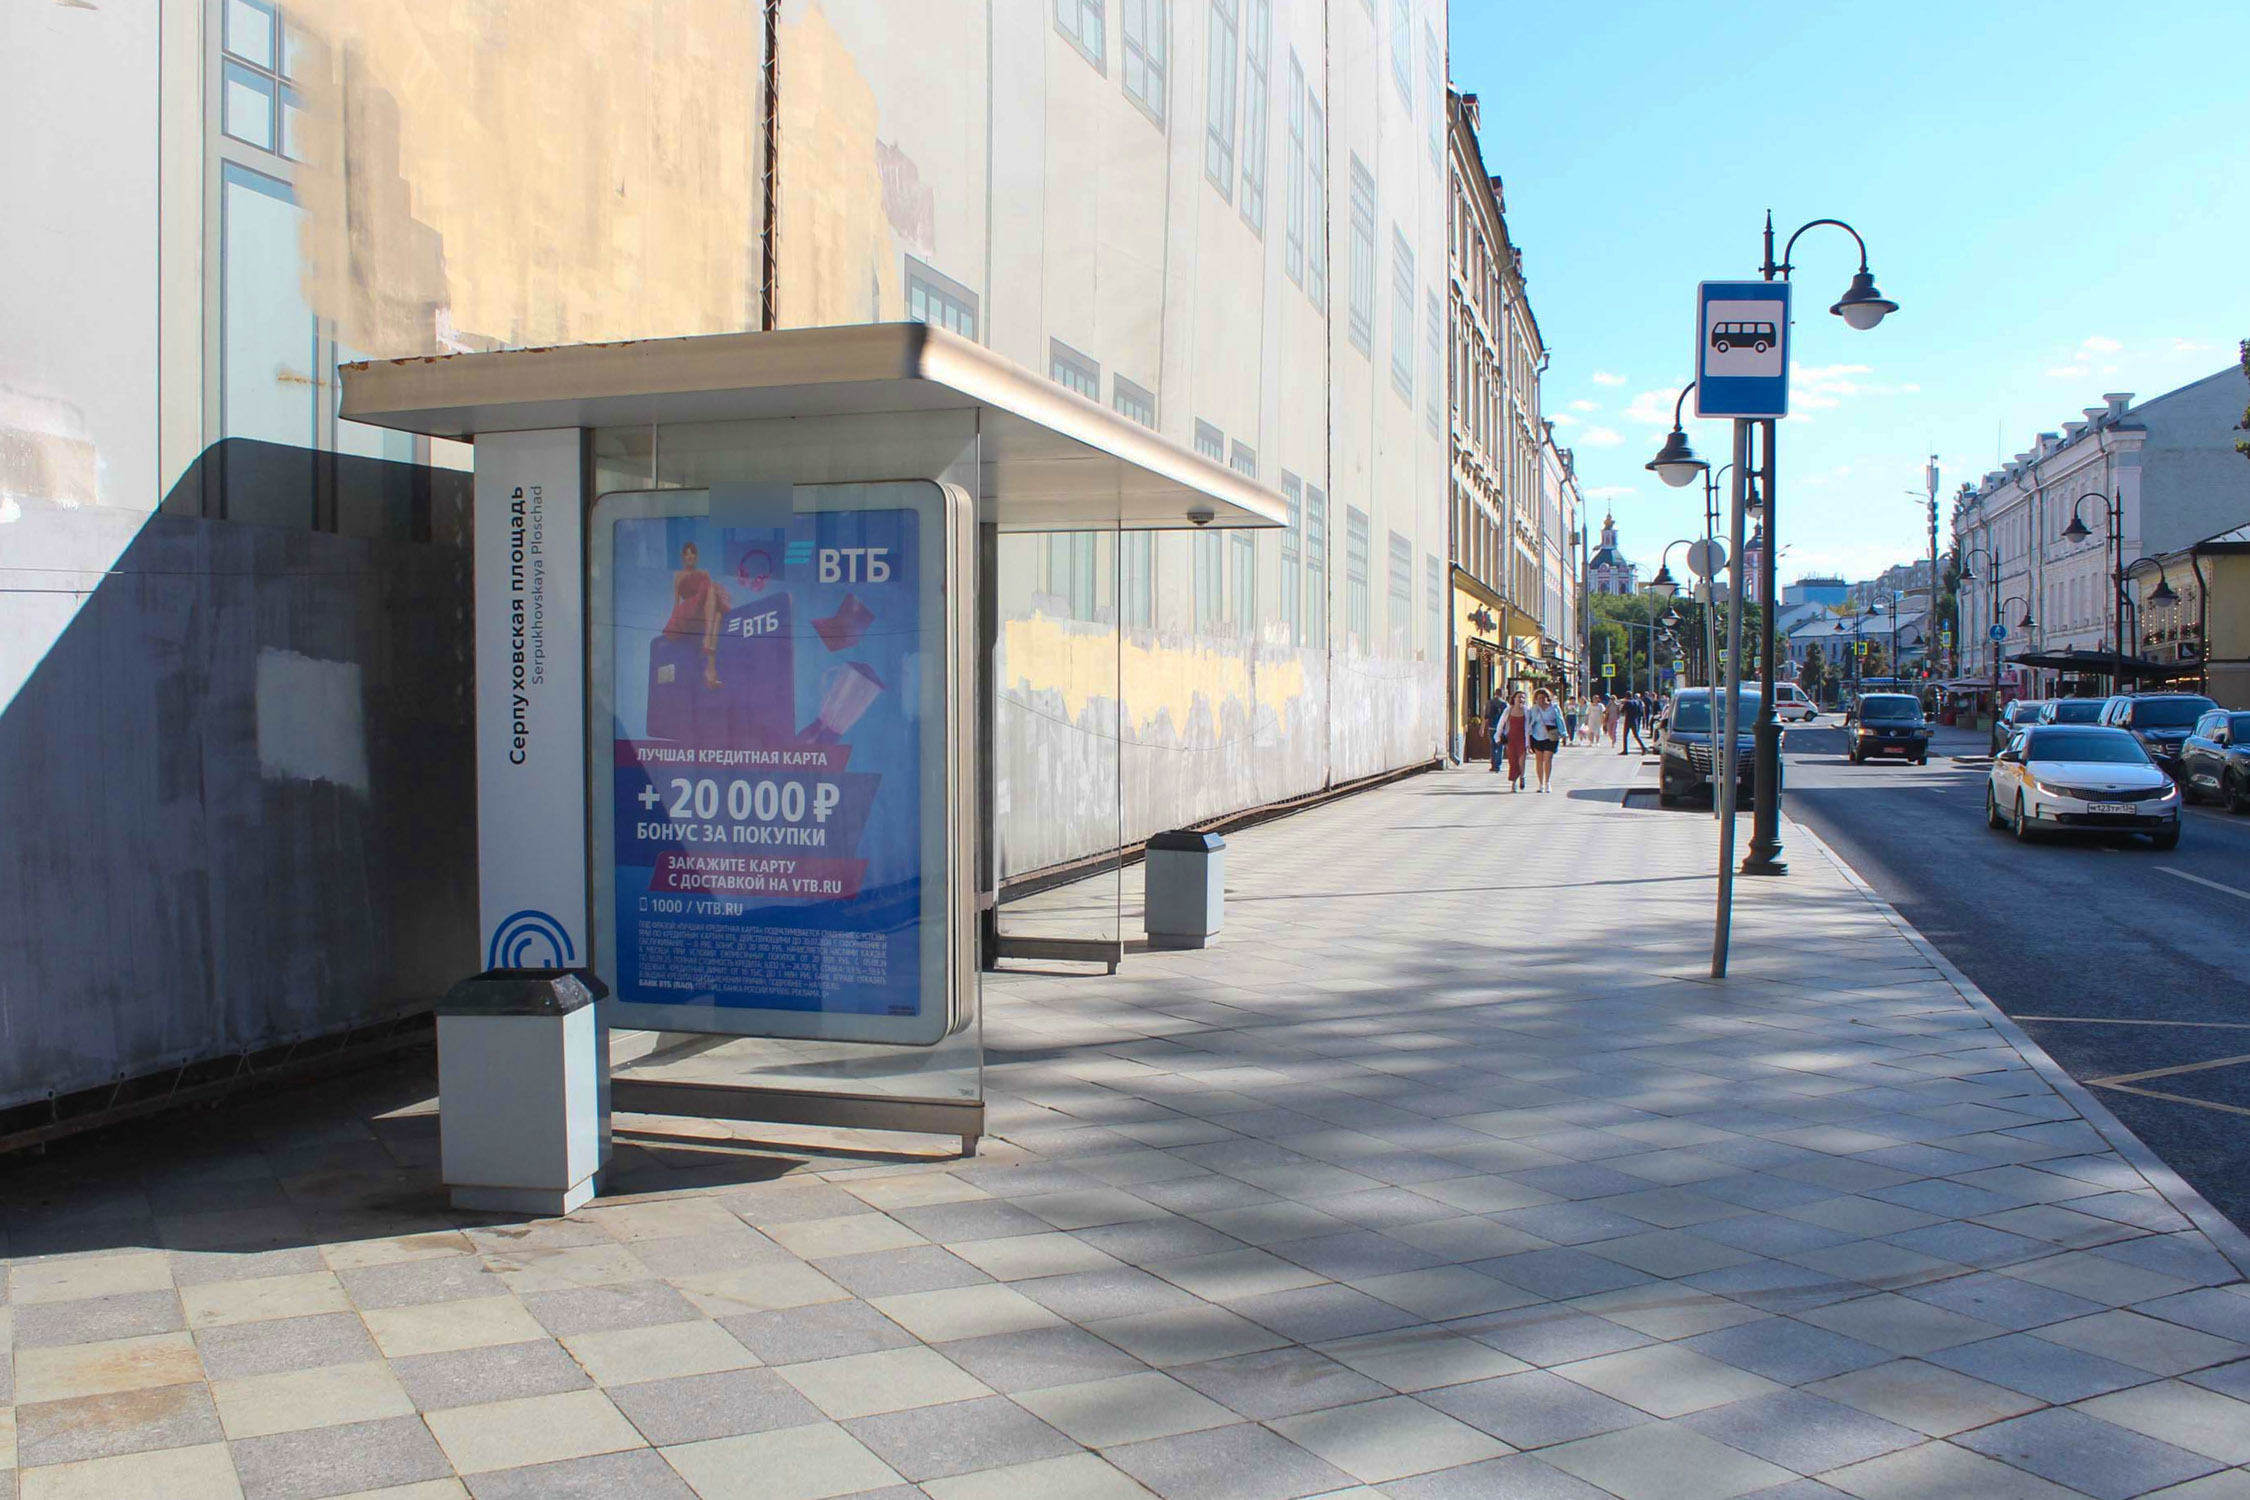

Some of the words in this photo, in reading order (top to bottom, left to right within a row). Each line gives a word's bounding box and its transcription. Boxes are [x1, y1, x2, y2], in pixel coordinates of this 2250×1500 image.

[530, 485, 543, 555] Ploschad
[512, 486, 526, 591] площадь
[819, 548, 890, 583] ВТБ
[530, 559, 546, 685] Serpukhovskaya
[743, 611, 779, 638] ВТБ
[636, 748, 695, 762] ЛУЧШАЯ
[699, 749, 779, 765] КРЕДИТНАЯ
[783, 752, 827, 766] КАРТА
[637, 822, 698, 841] БОНУС
[703, 824, 727, 842] ЗА
[733, 825, 826, 846] ПОКУПКИ
[668, 855, 745, 872] ЗАКАЖИТЕ
[750, 859, 796, 874] КАРТУ
[668, 873, 677, 886] С
[680, 874, 765, 891] ДОСТАВКОЙ
[769, 878, 789, 892] НА
[792, 879, 841, 894] VTB.RU
[652, 899, 682, 913] 1000
[696, 901, 743, 916] VTB.RU
